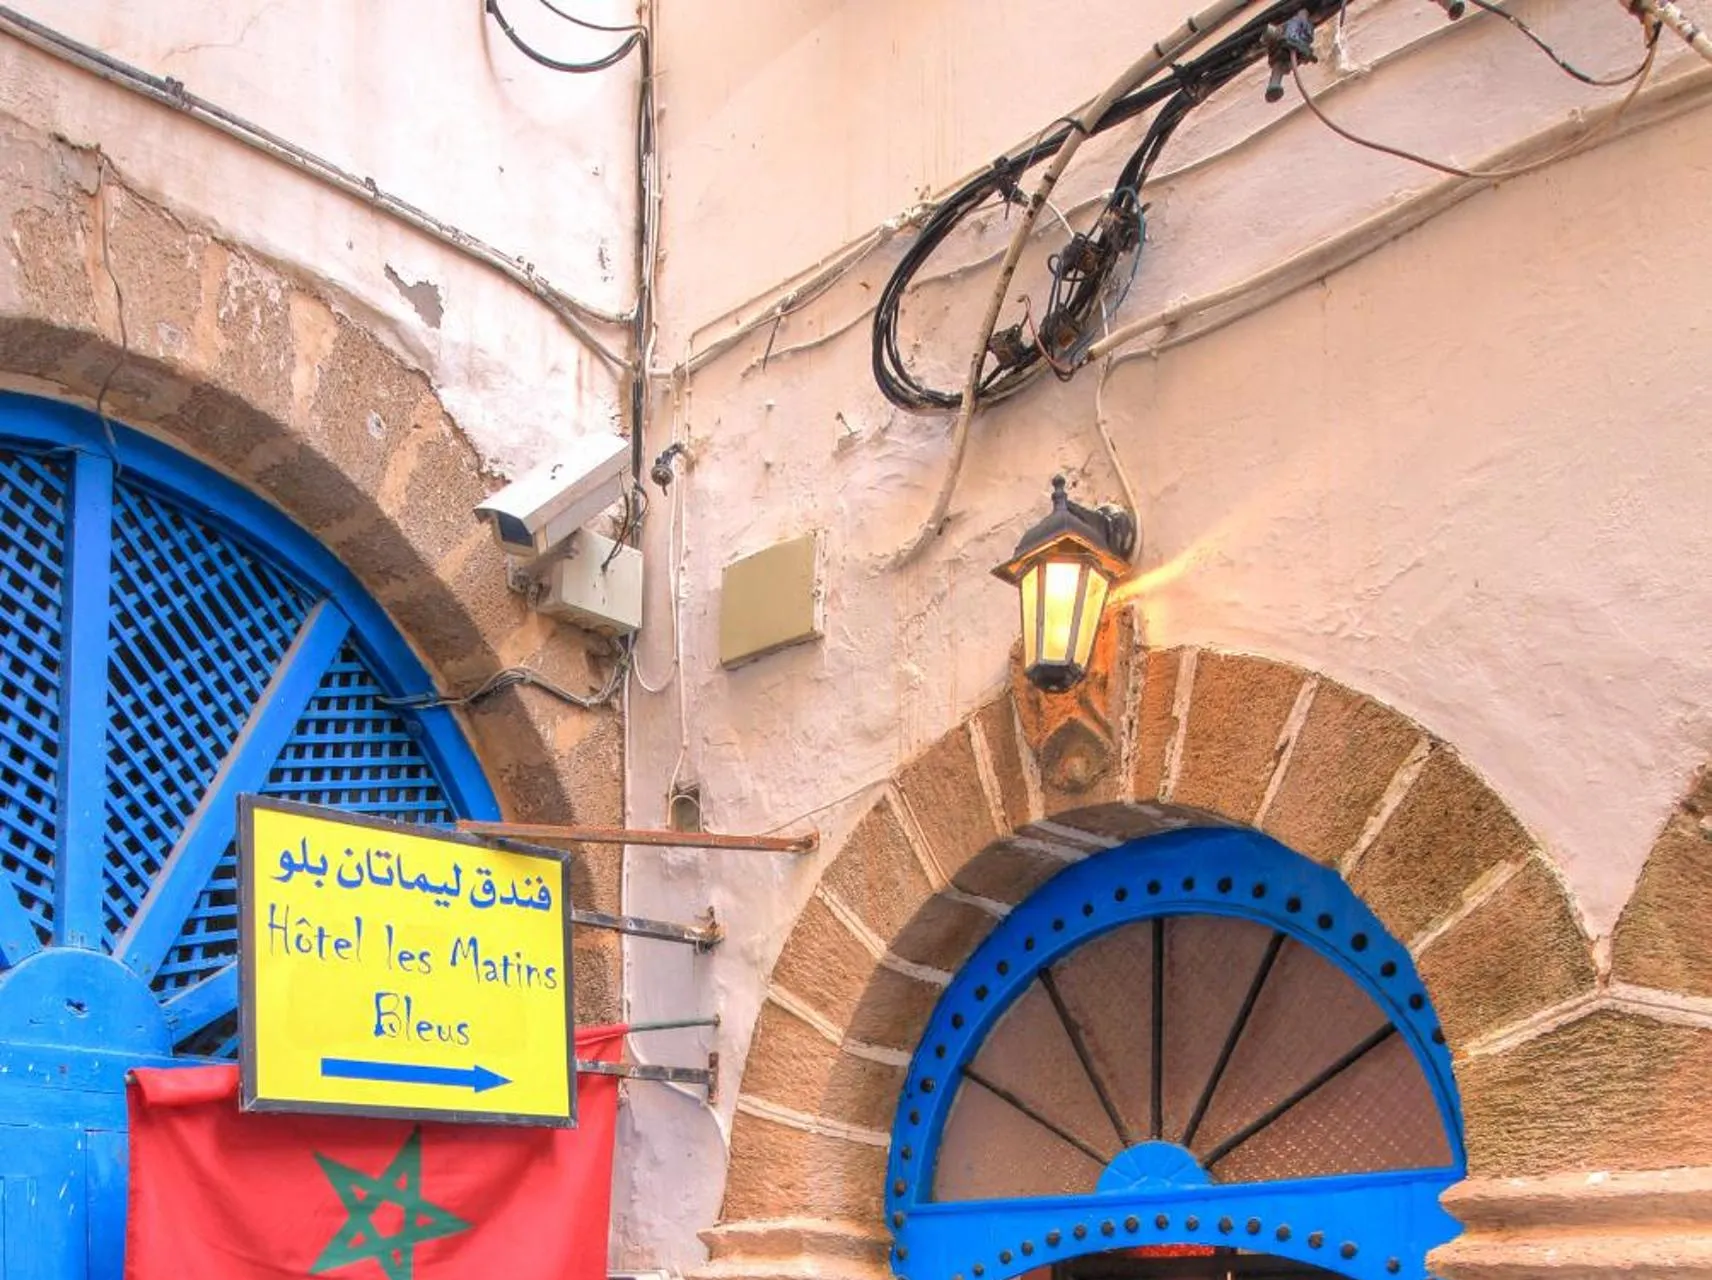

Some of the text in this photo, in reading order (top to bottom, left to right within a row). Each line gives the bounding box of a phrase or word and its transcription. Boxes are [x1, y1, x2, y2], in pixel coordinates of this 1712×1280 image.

[273, 836, 552, 912] فندق ليماتان بلو
[267, 902, 558, 990] Hôtel les Matins
[373, 991, 471, 1046] Bleus
